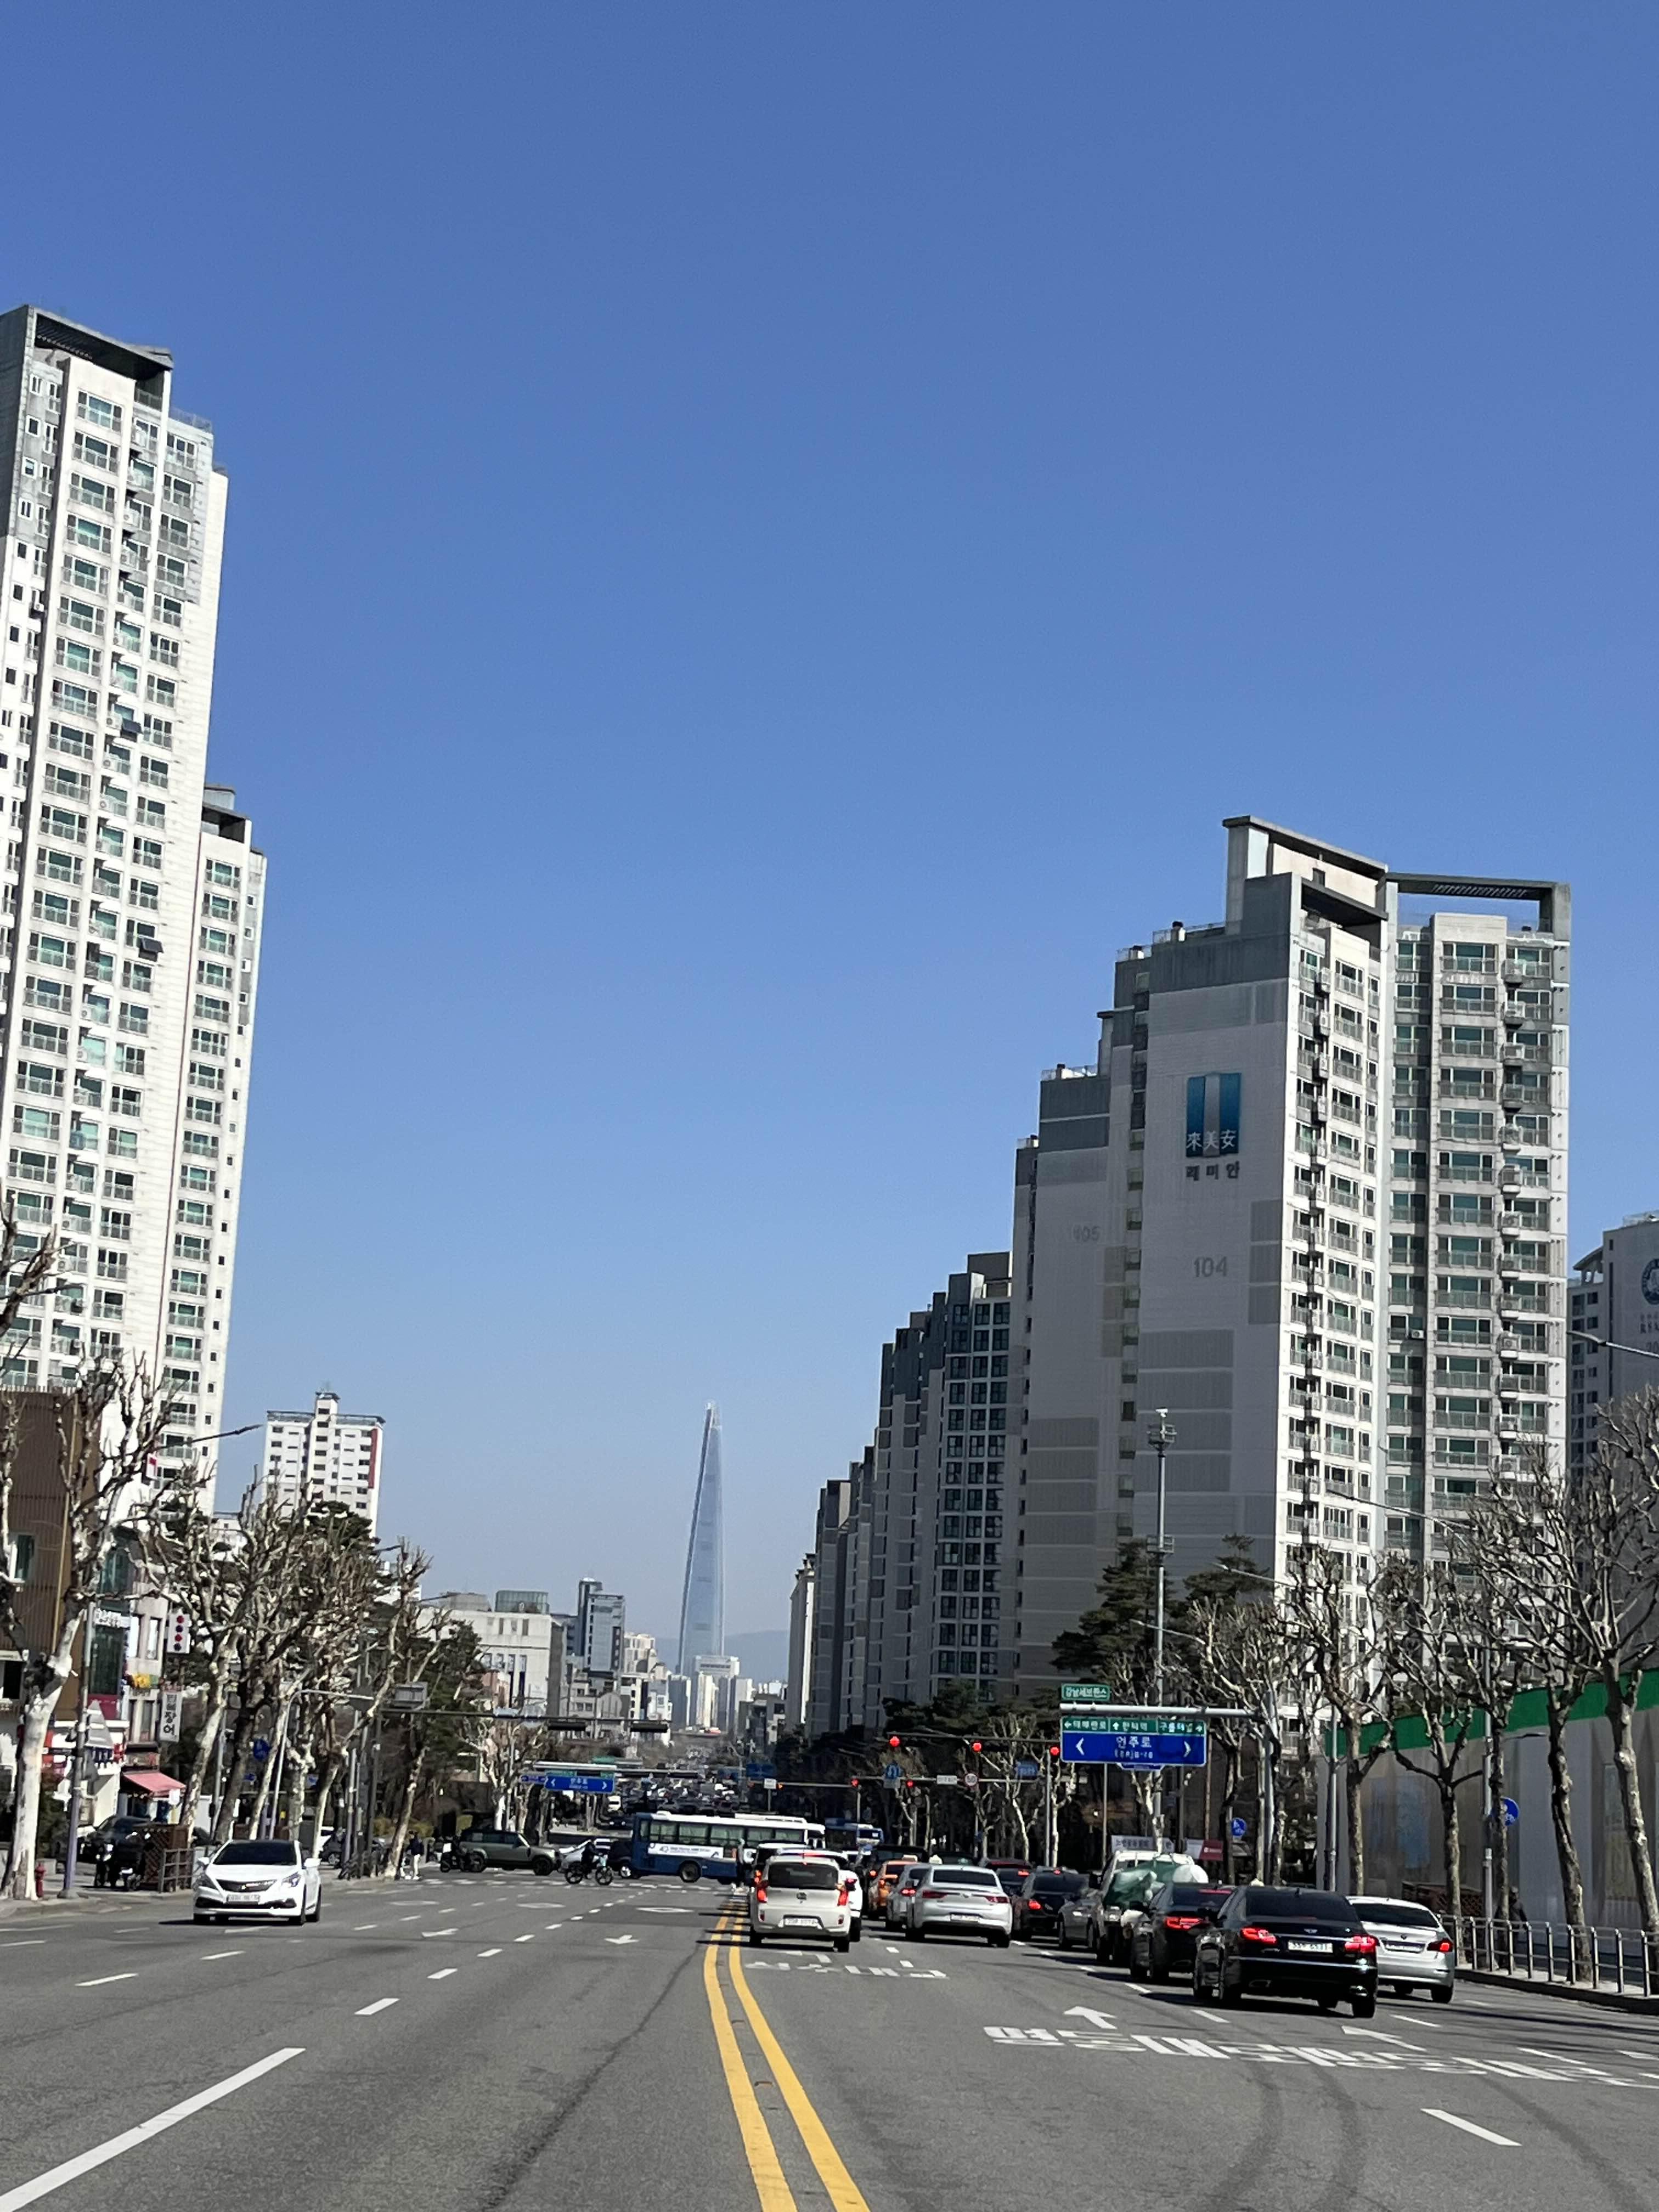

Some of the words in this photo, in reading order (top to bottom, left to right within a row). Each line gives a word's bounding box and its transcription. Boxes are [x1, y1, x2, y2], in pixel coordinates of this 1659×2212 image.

[1186, 1160, 1240, 1181] 래미안
[1194, 1256, 1227, 1278] 104
[1116, 1736, 1152, 1749] 언주로
